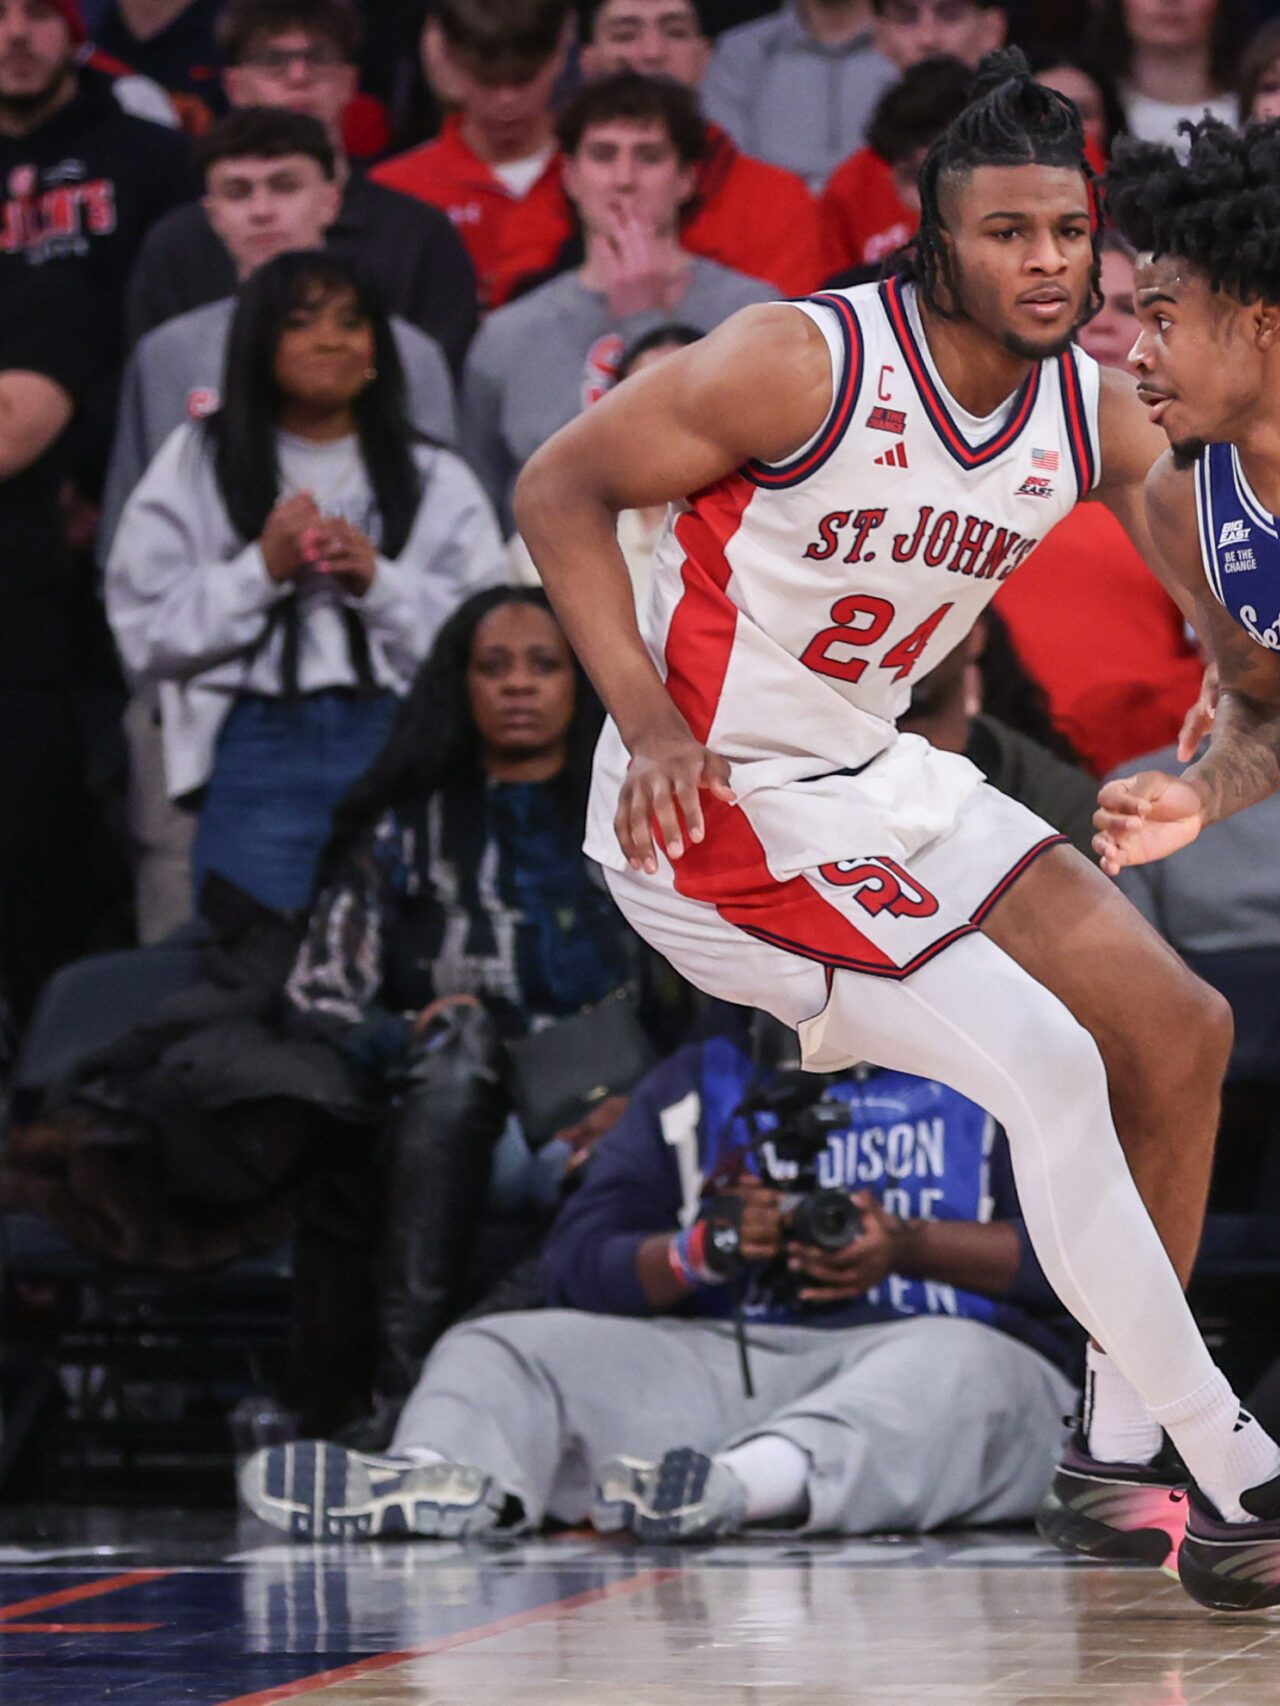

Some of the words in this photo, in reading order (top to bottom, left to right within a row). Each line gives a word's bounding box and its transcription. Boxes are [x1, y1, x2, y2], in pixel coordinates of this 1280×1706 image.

[878, 365, 894, 401] C
[1025, 475, 1051, 487] BIG
[1018, 484, 1055, 497] EAST
[1221, 519, 1244, 533] BIG
[802, 507, 888, 564] ST.
[1219, 528, 1252, 544] EAST
[1224, 551, 1237, 563] BE
[1237, 548, 1254, 561] THE
[1224, 558, 1257, 574] CHANGE
[800, 594, 955, 686] 24
